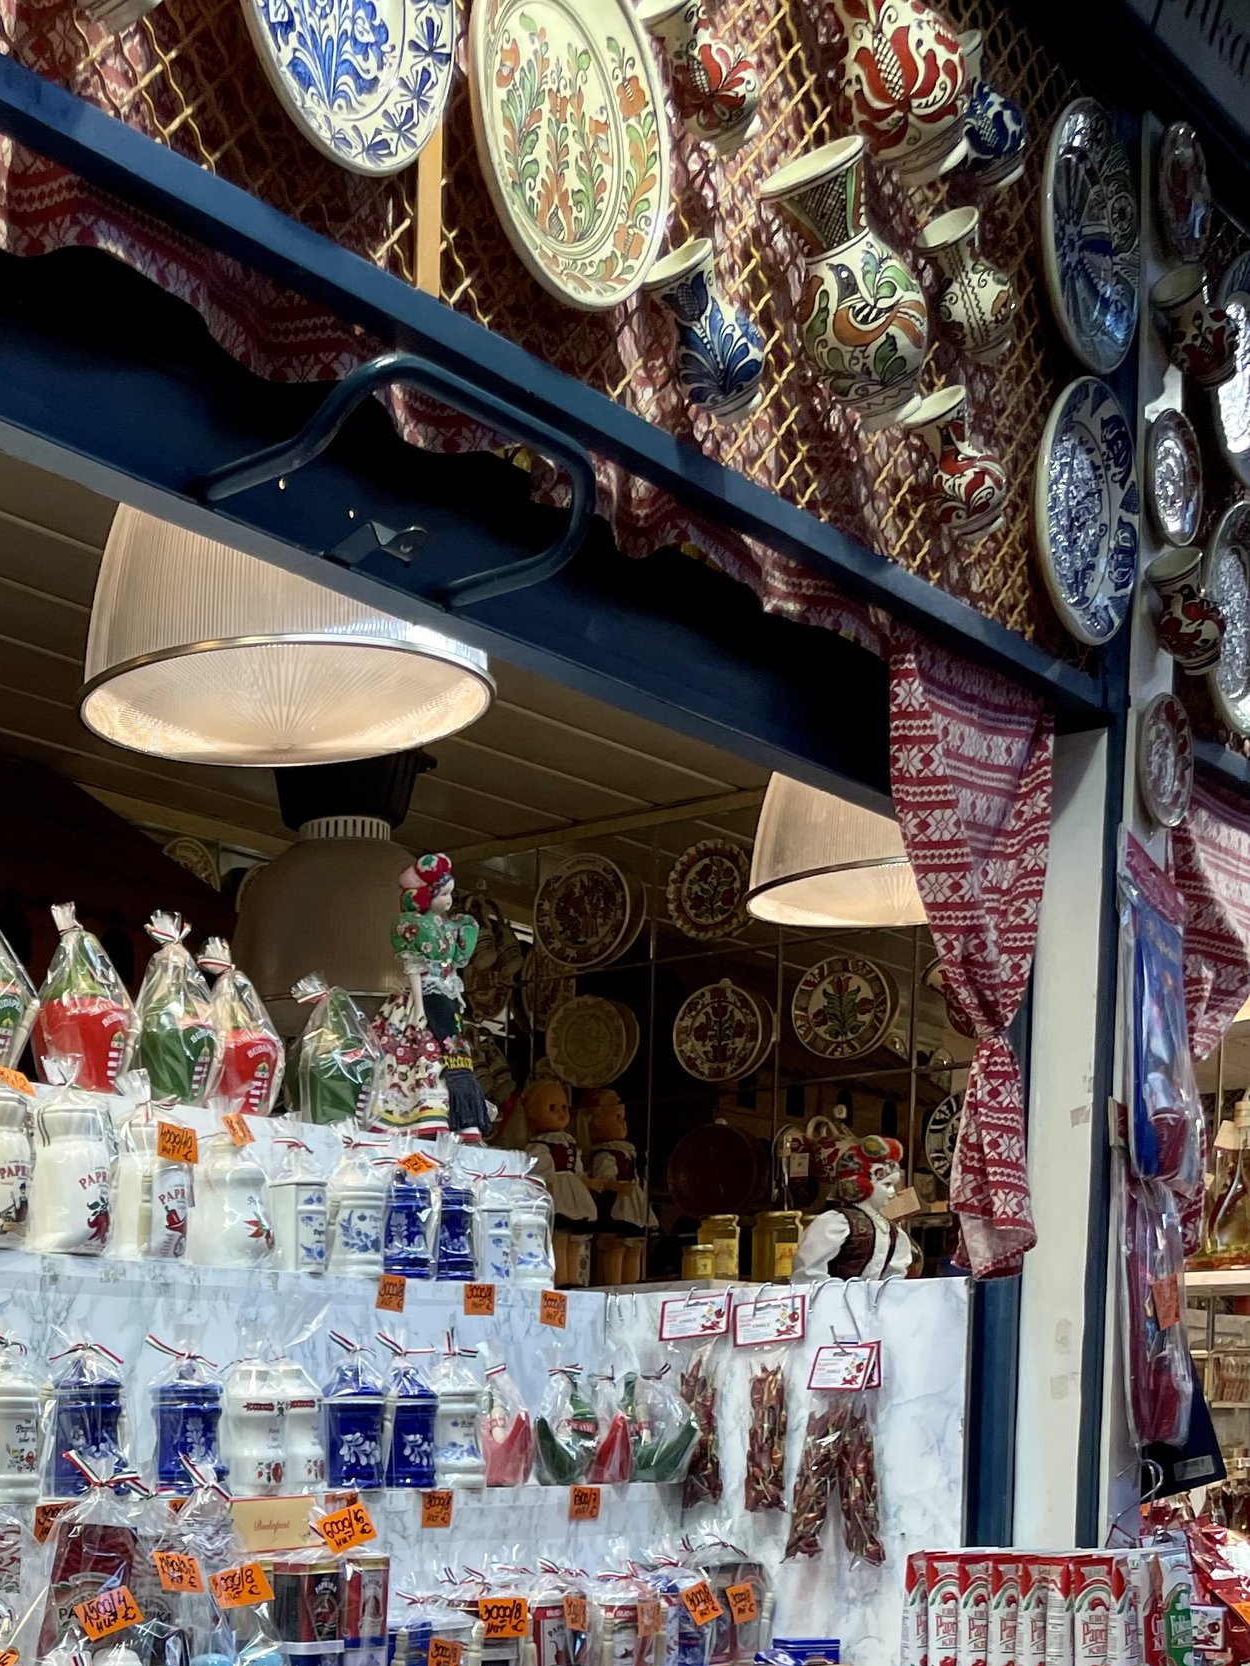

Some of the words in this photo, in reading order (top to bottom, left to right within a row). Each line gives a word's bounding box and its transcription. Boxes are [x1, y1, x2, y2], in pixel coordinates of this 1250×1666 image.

[253, 1518, 291, 1533] Budapest
[322, 1508, 365, 1540] 6000/16
[83, 1591, 129, 1626] 1500/4
[481, 1600, 522, 1622] 3000/8
